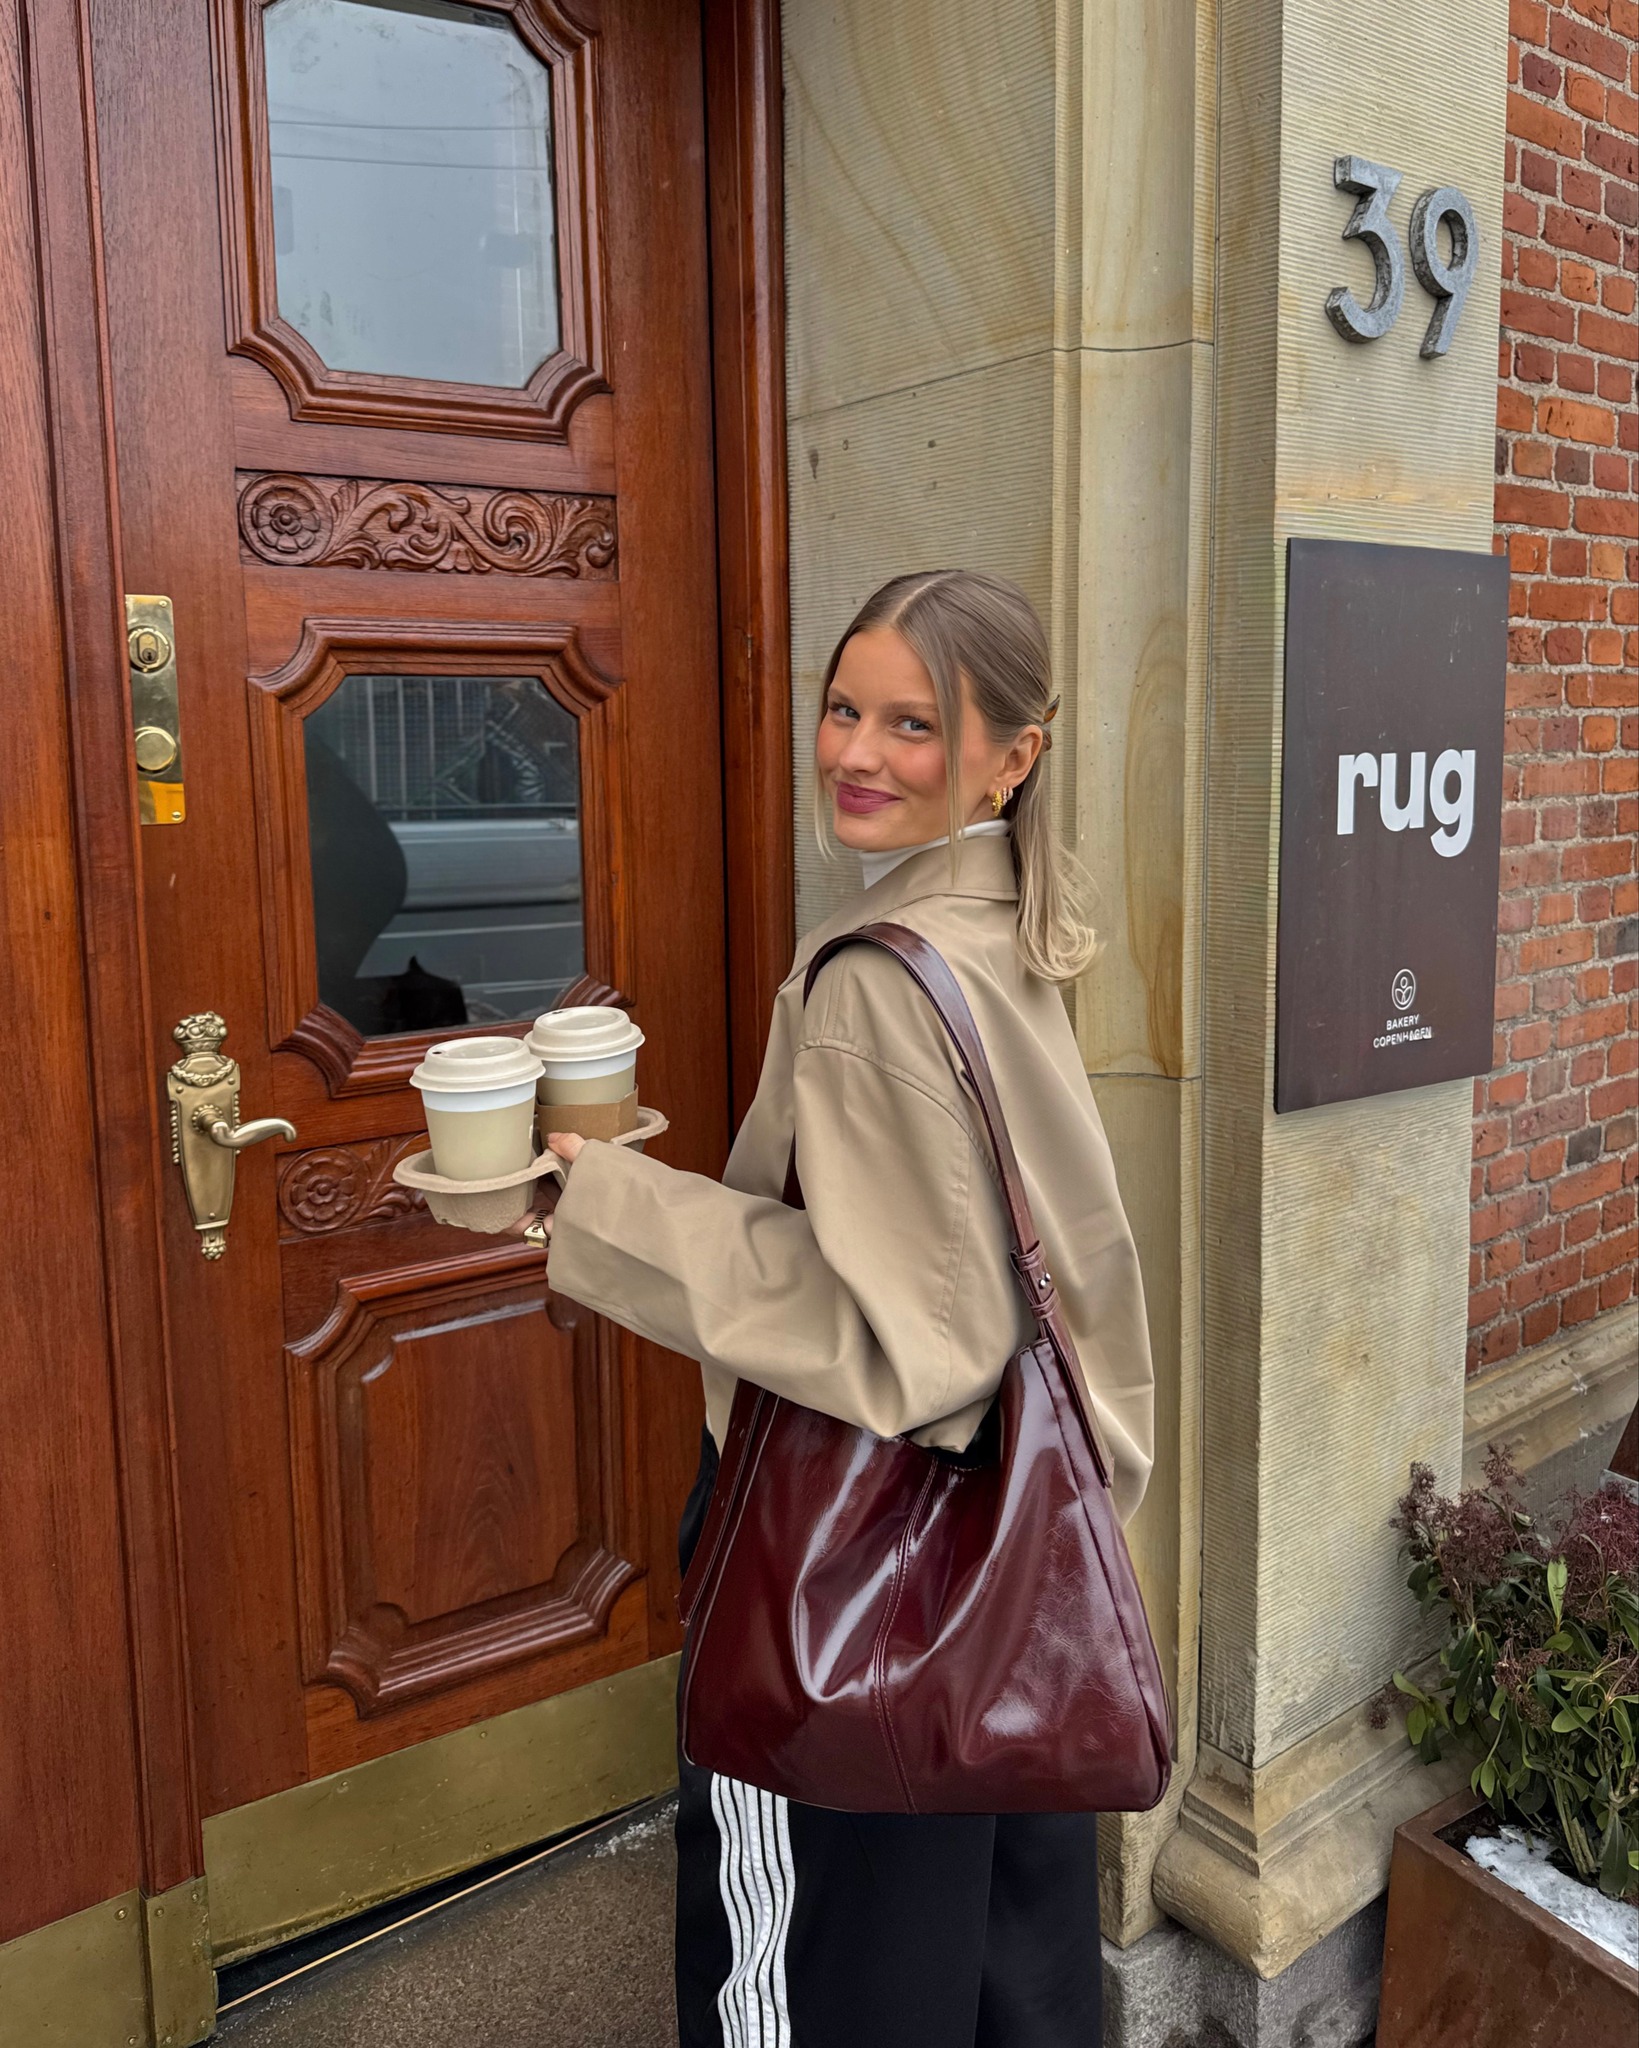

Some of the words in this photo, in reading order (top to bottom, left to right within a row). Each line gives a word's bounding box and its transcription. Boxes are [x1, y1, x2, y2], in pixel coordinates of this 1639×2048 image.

[1325, 155, 1479, 360] 39
[1337, 748, 1476, 858] rug
[1373, 1026, 1432, 1049] COPENHAGEN
[1386, 1014, 1420, 1031] BAKERY
